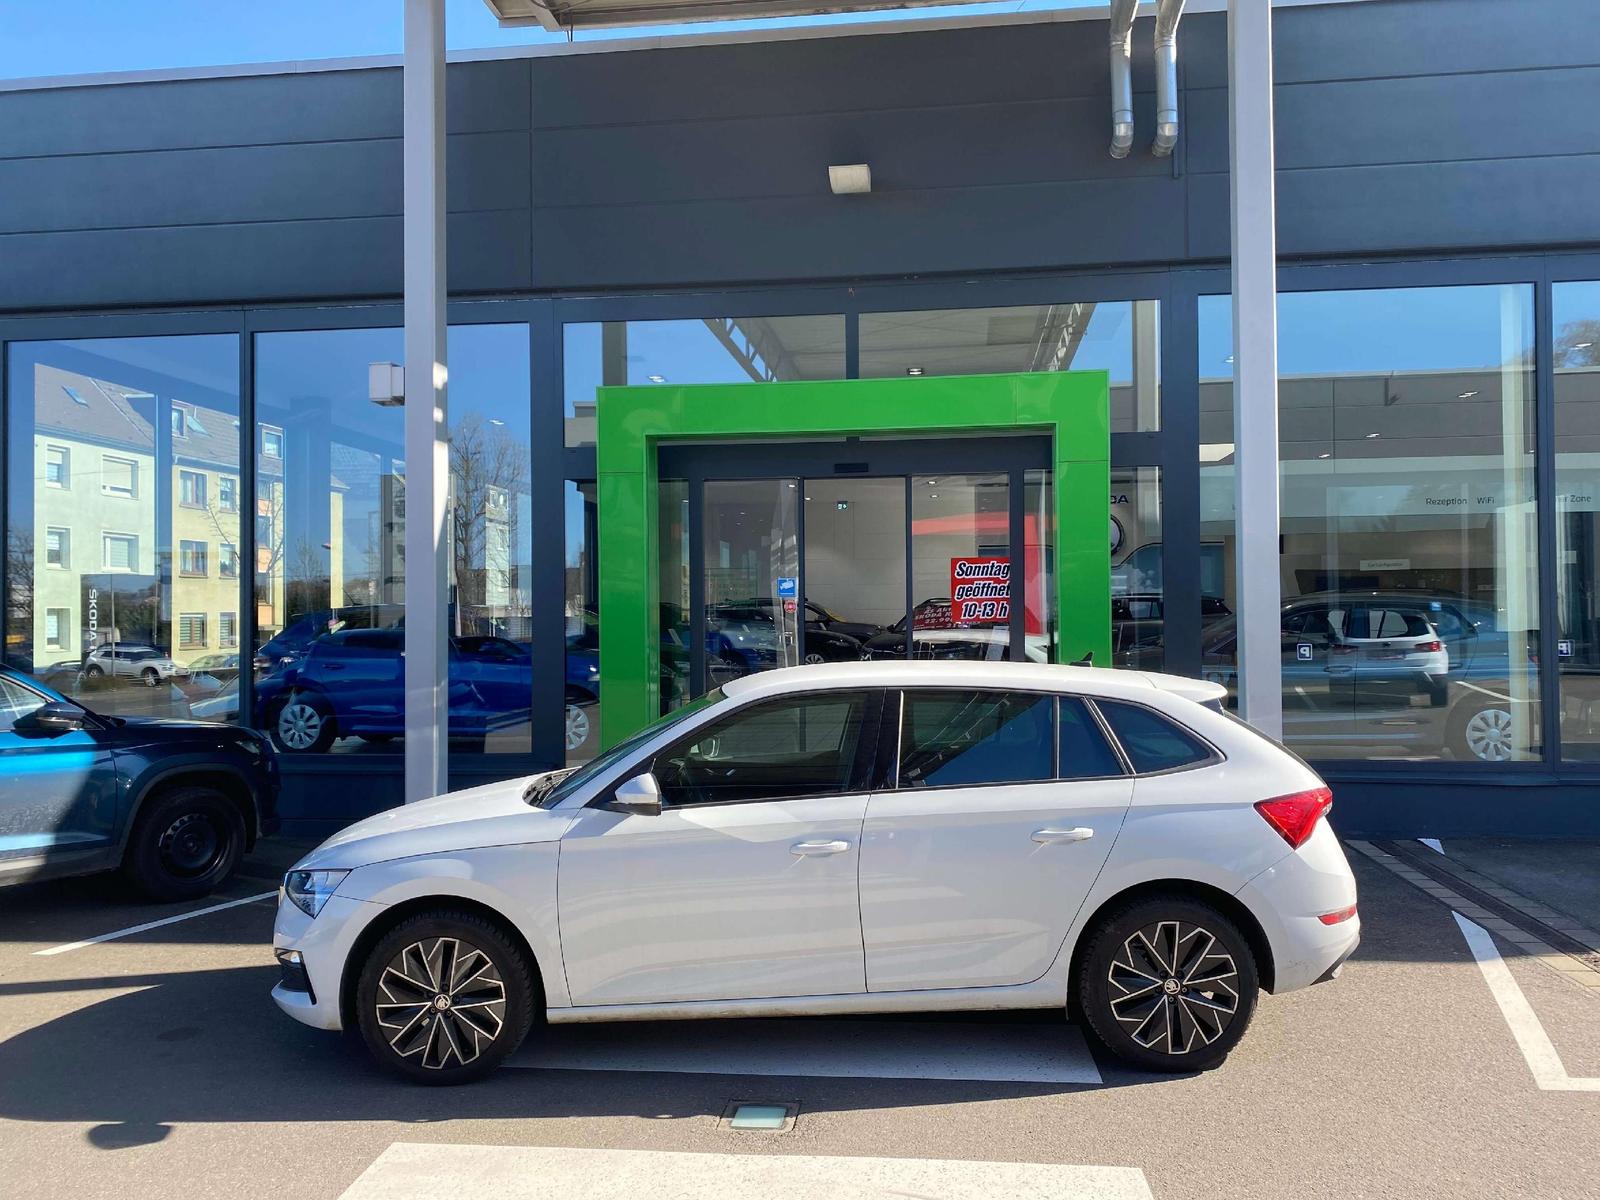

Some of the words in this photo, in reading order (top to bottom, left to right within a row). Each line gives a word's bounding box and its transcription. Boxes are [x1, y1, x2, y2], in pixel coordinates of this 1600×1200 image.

[1425, 496, 1468, 506] Rezeption
[1476, 496, 1496, 505] WiFi
[1570, 494, 1592, 503] Zone
[955, 561, 1010, 579] Sonntag
[955, 581, 1010, 601] geöffnet
[961, 601, 997, 619] 10-13
[997, 601, 1009, 618] h
